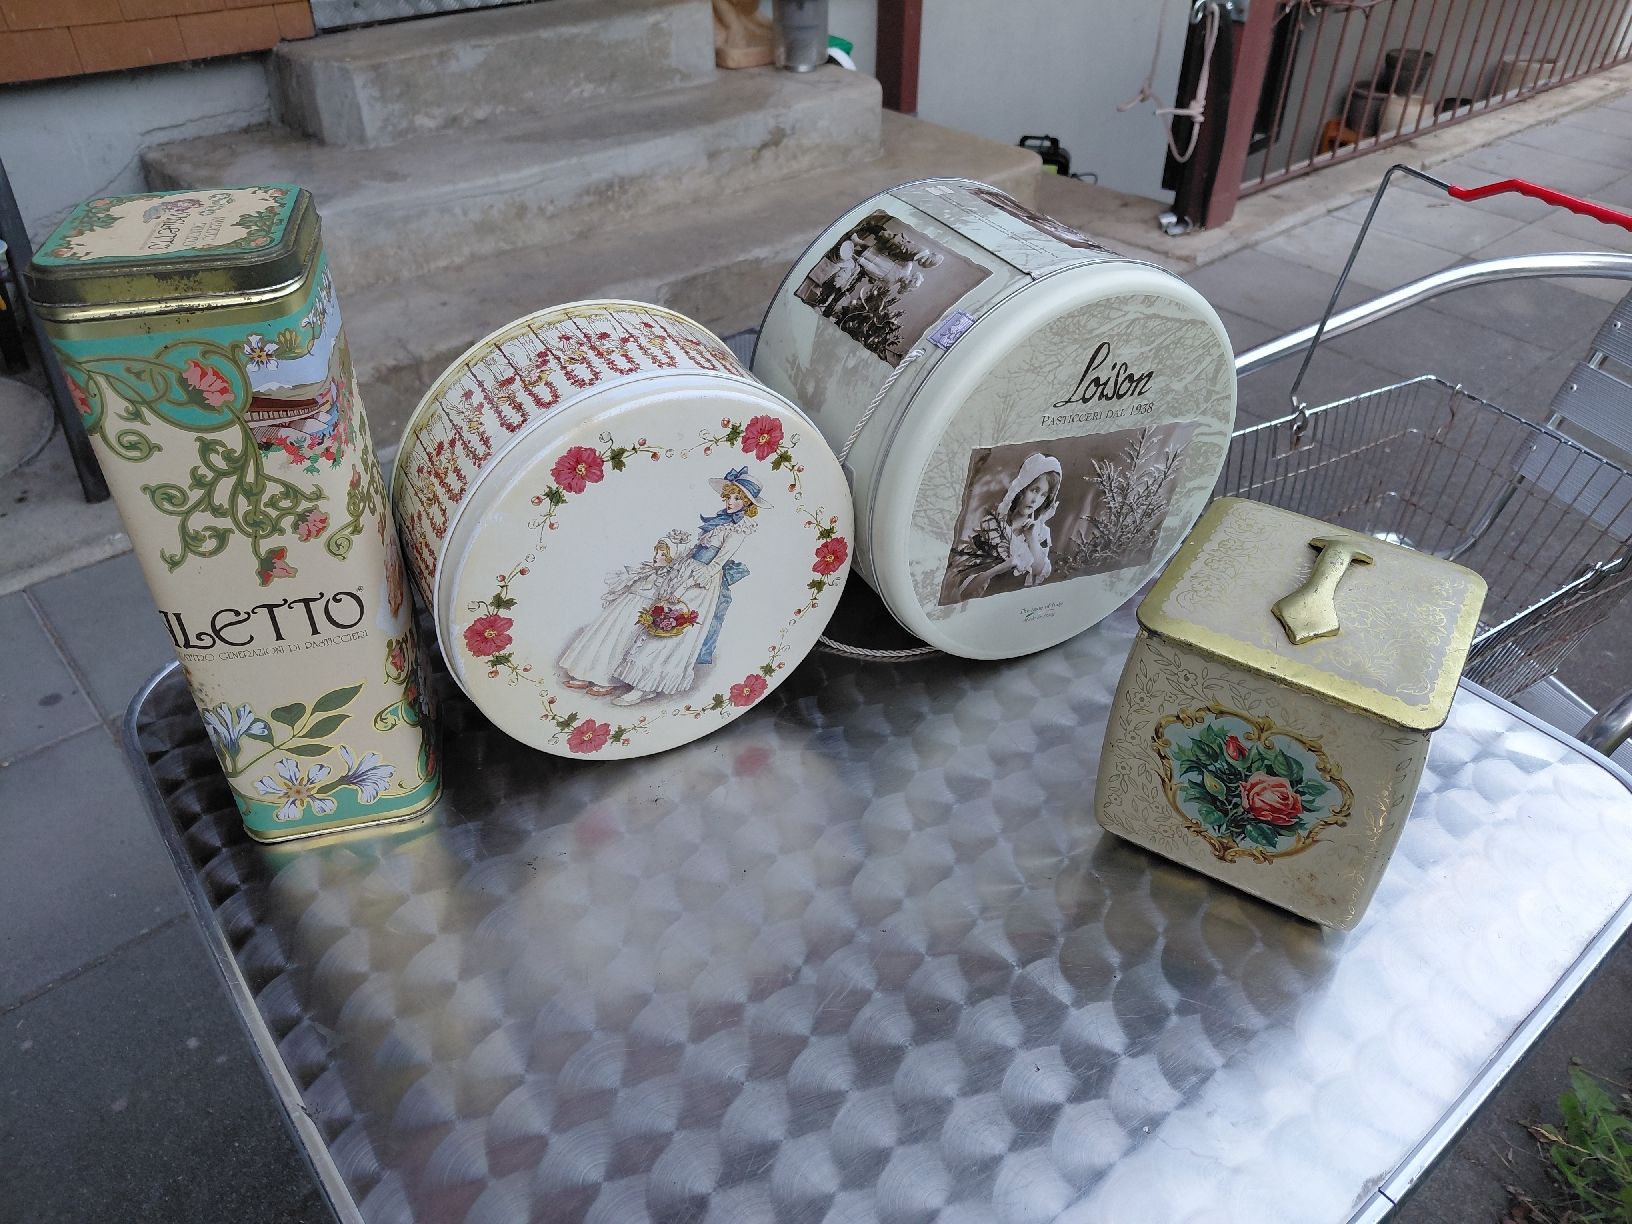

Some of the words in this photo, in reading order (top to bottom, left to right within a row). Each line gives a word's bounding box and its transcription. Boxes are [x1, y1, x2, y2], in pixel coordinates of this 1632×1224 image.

[1052, 341, 1155, 408] Loison
[1040, 411, 1103, 427] PASTICCERI
[1105, 408, 1126, 419] DAL
[1129, 401, 1155, 417] 1938
